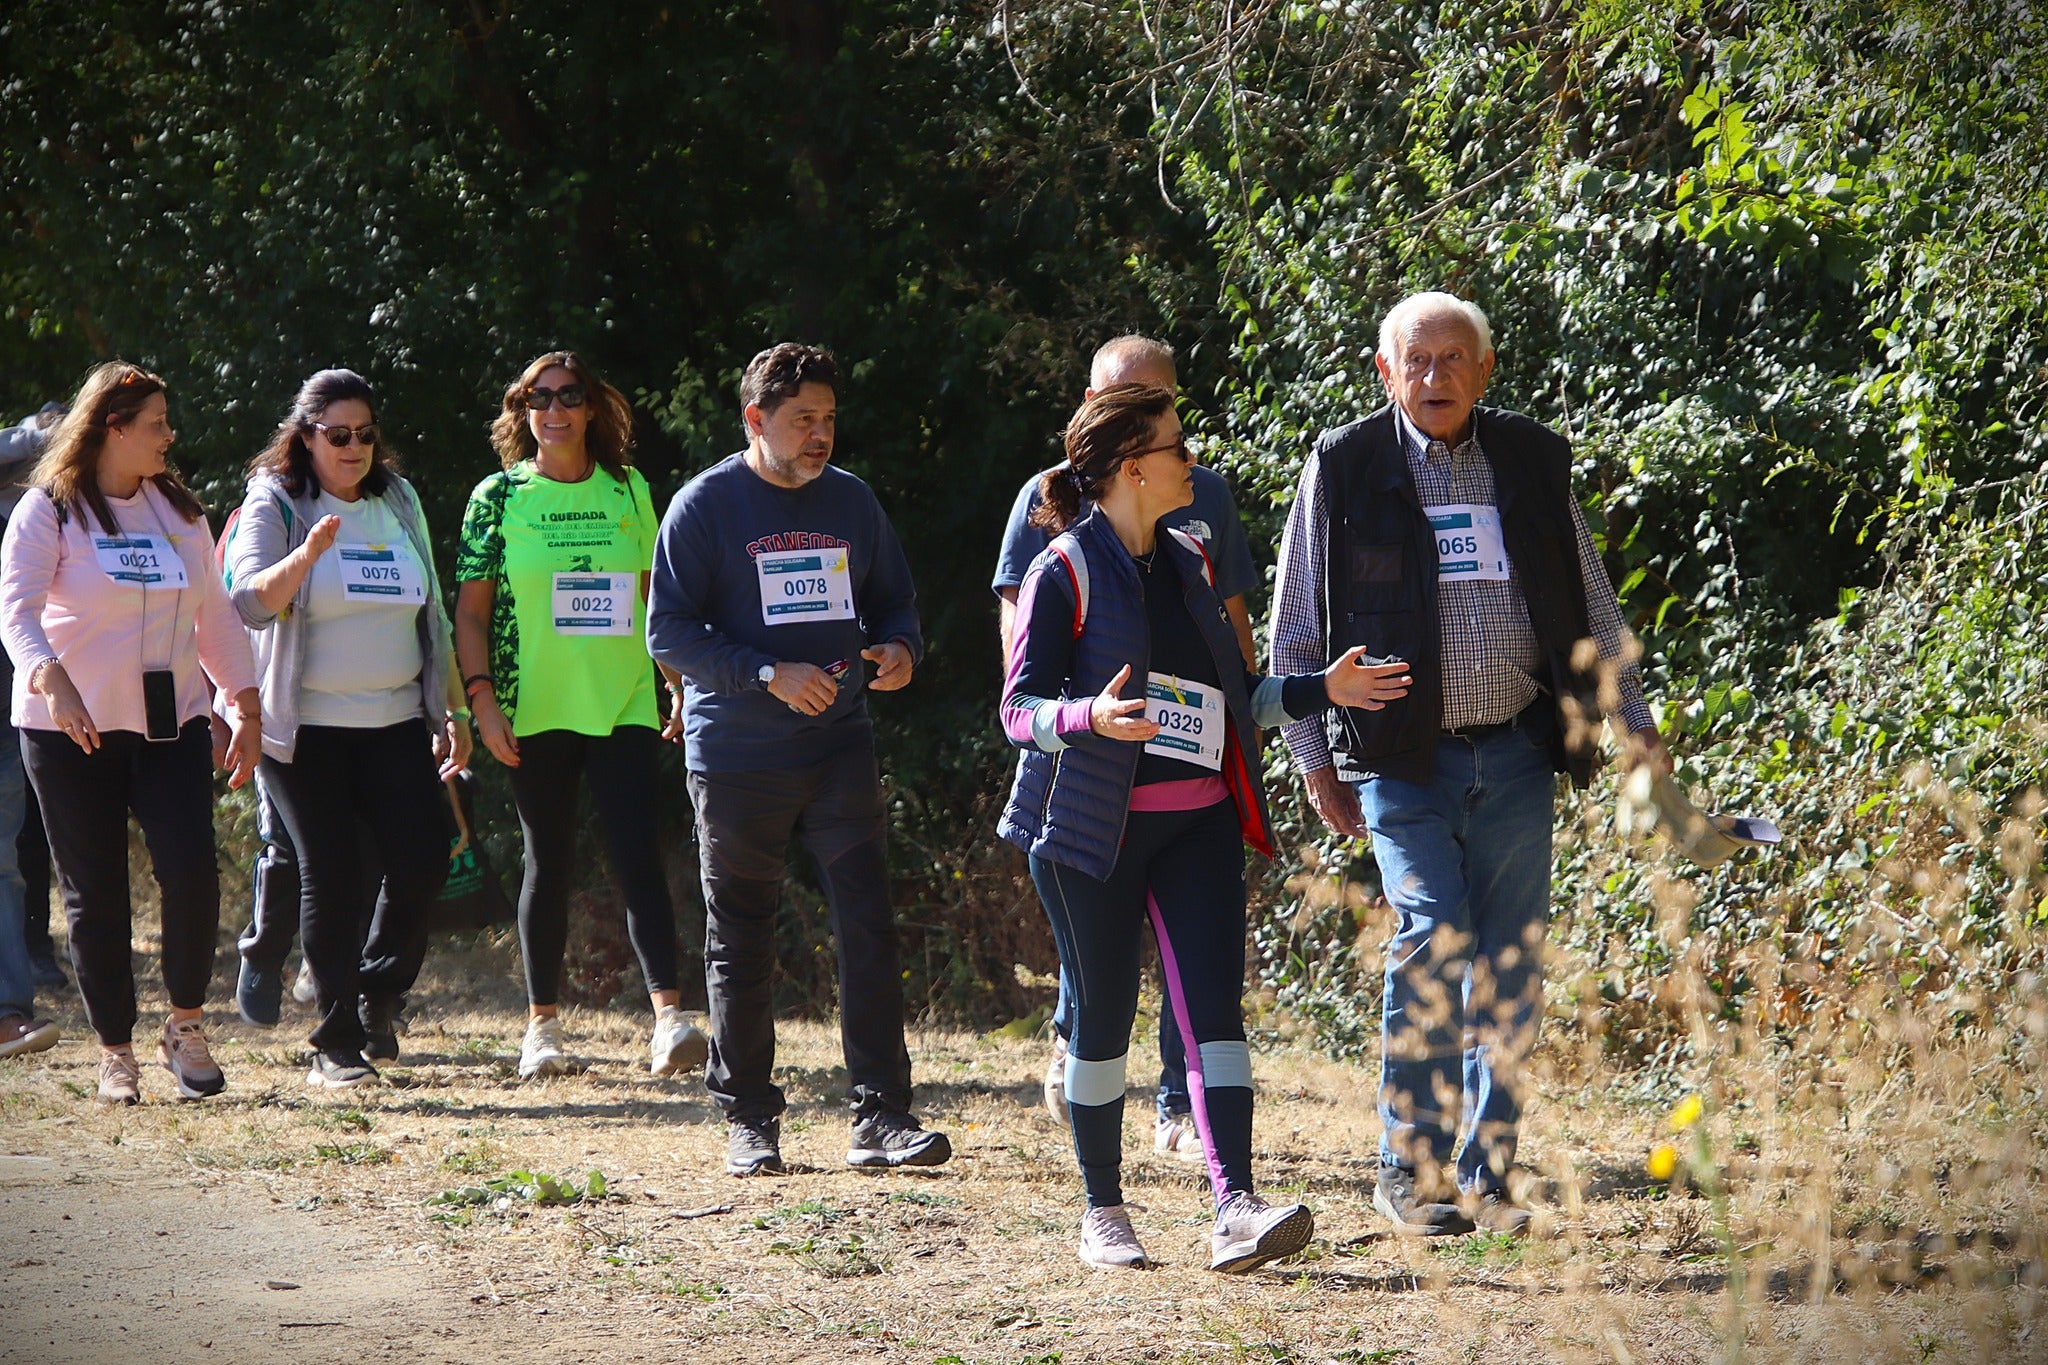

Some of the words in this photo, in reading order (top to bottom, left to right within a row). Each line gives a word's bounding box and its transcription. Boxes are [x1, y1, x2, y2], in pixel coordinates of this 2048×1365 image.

[541, 513, 546, 522] I
[549, 511, 607, 522] QUEDADA
[547, 540, 613, 548] CASTROMONTE
[119, 553, 160, 568] 0021
[361, 566, 400, 581] 0076
[784, 578, 827, 597] 0078
[572, 597, 612, 612] 0022
[1158, 709, 1203, 735] 0329
[1166, 738, 1183, 747] OCTUBRE
